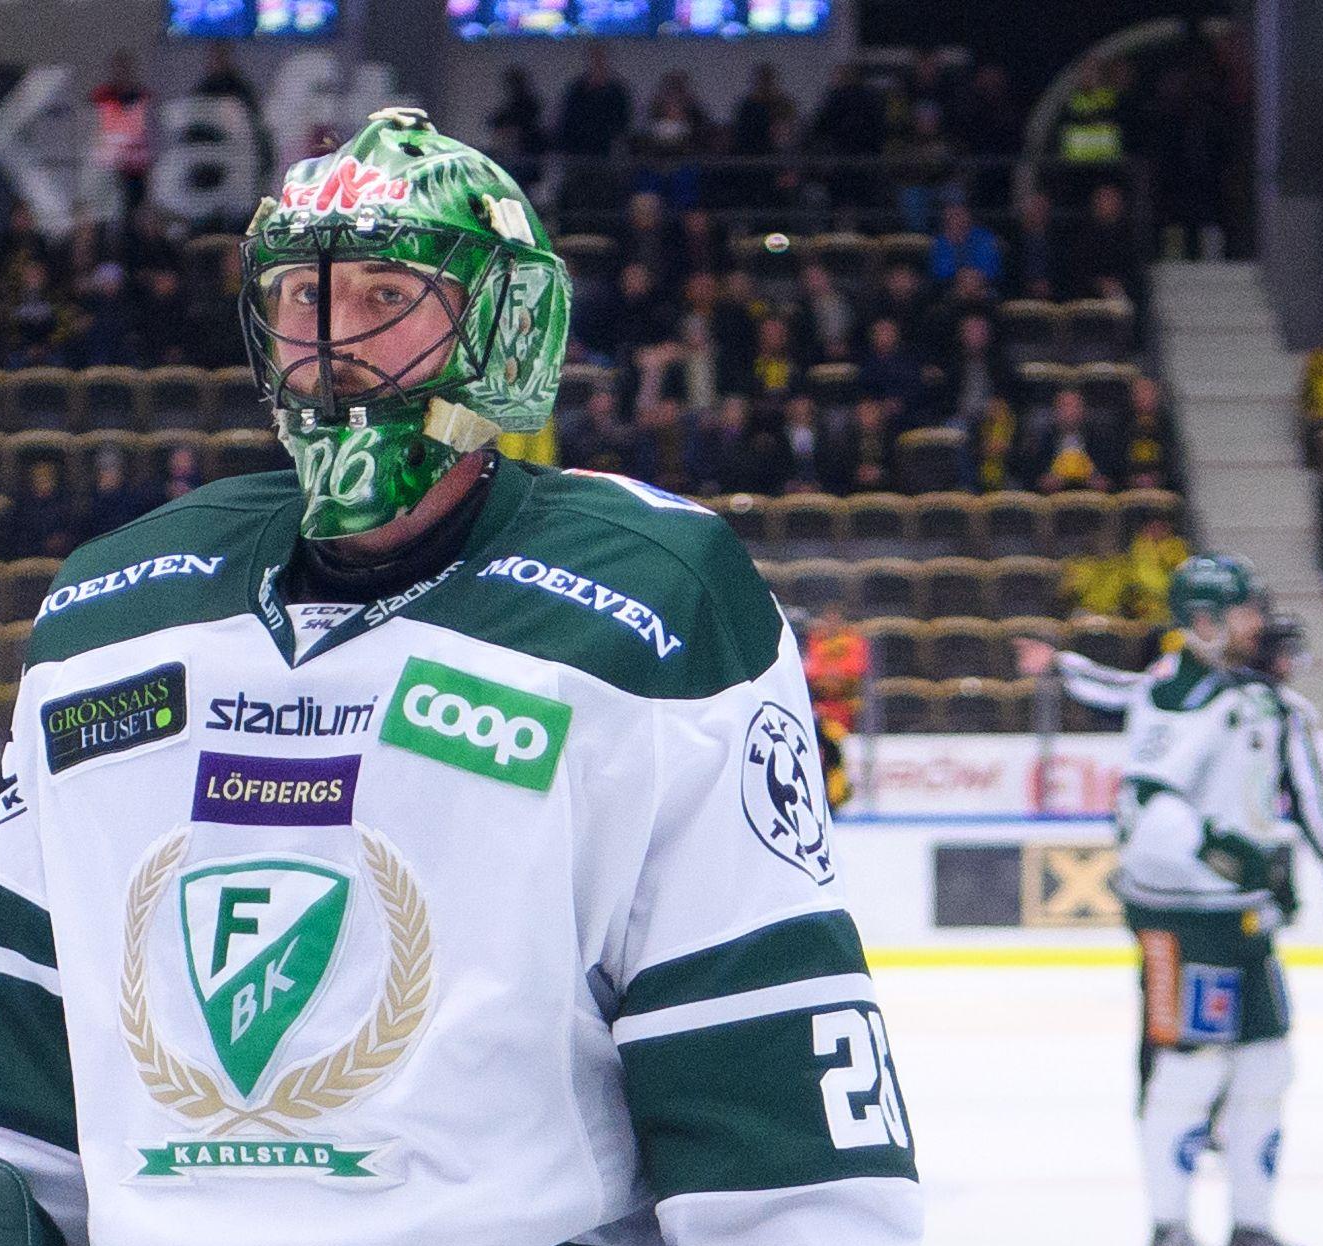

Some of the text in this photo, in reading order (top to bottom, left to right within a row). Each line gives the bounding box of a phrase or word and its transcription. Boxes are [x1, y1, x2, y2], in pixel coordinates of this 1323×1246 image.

[300, 606, 355, 616] CCM
[477, 555, 682, 659] MOELVEN
[49, 677, 170, 733] GRÖNSAKS
[205, 692, 375, 736] stadium
[402, 684, 549, 766] coop
[80, 707, 156, 748] HUSET
[206, 772, 342, 803] LÖFBERGS
[174, 1146, 330, 1164] KARLSTAD
